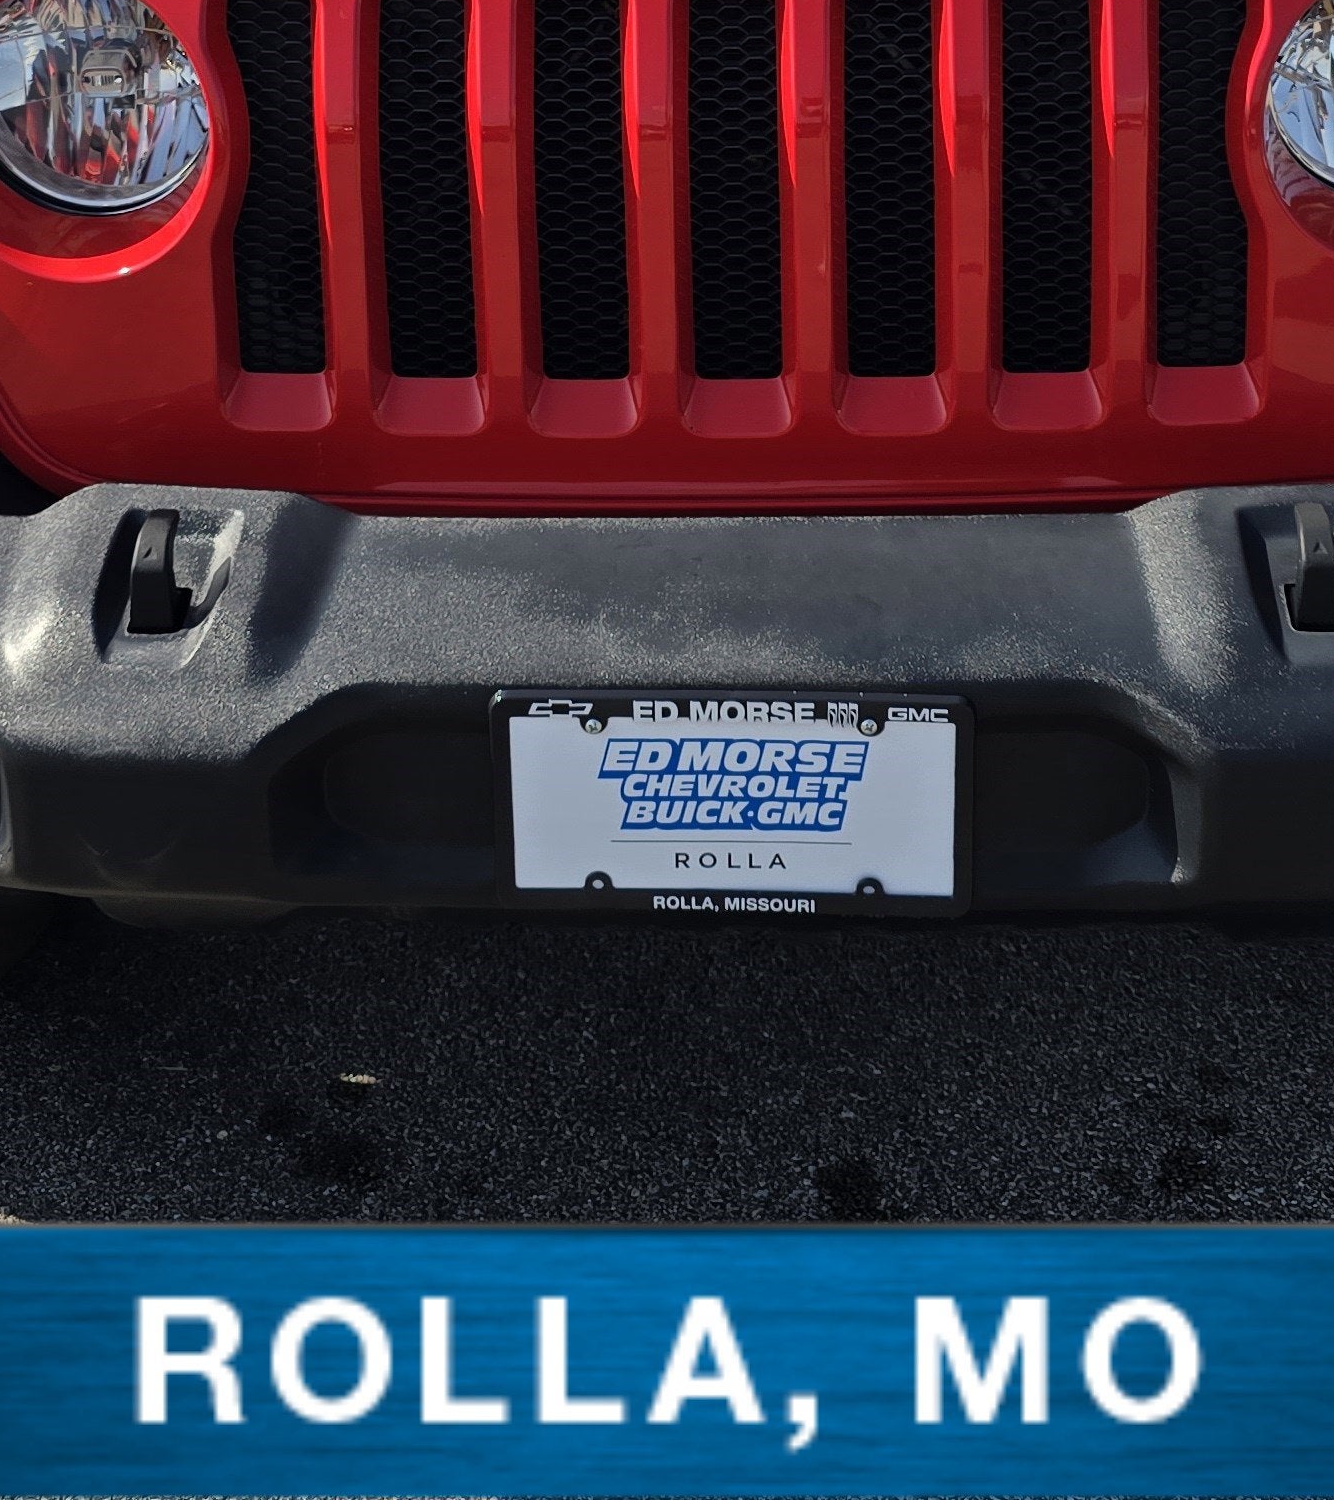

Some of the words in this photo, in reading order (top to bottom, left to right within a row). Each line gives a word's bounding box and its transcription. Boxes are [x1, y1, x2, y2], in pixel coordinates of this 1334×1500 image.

[633, 700, 678, 722] ED
[689, 700, 815, 723] MORSE
[887, 707, 949, 722] GMC
[603, 741, 672, 772] ED
[677, 741, 867, 775] MORSE
[623, 774, 847, 799] CHEVROLET
[675, 852, 786, 869] ROLLA
[653, 895, 719, 912] ROLLA,
[724, 897, 816, 913] MISSOURI
